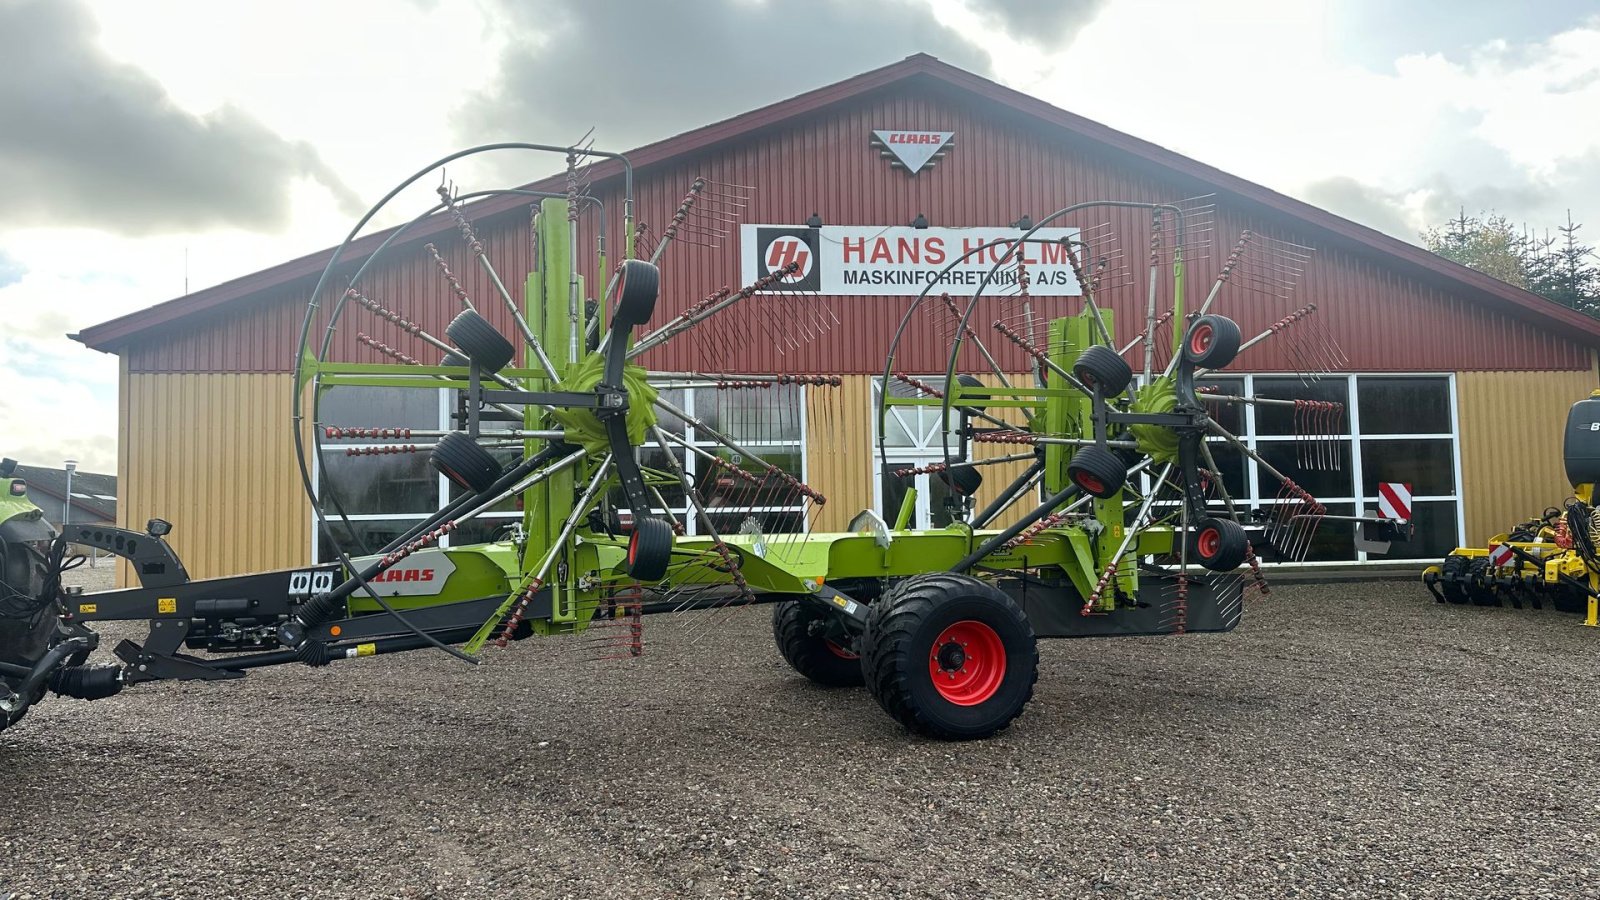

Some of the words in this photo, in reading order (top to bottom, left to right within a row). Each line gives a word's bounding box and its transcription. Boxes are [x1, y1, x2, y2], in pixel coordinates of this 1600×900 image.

[889, 134, 941, 144] CLAAS
[843, 236, 947, 265] HANS
[962, 237, 1068, 265] HOLM
[1036, 270, 1067, 285] A/S
[368, 569, 434, 582] LAAS
